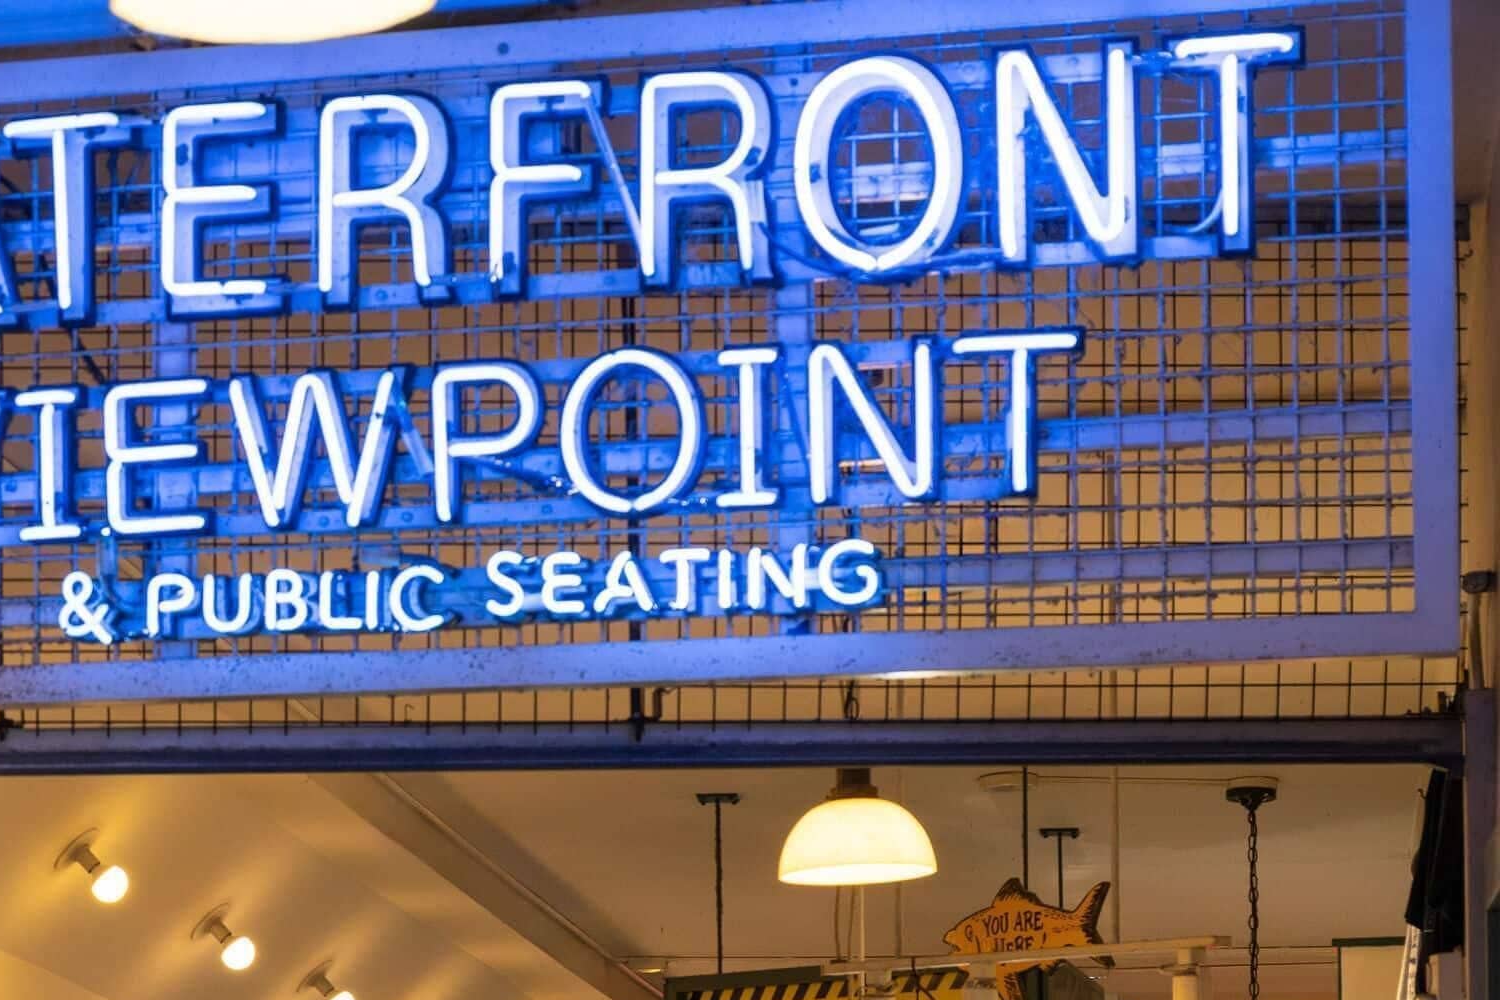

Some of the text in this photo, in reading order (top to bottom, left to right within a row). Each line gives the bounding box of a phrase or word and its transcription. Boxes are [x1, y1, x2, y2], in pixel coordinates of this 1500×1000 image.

[59, 539, 882, 645] & PUBLIC SEATING
[982, 910, 1044, 937] YOU ARE
